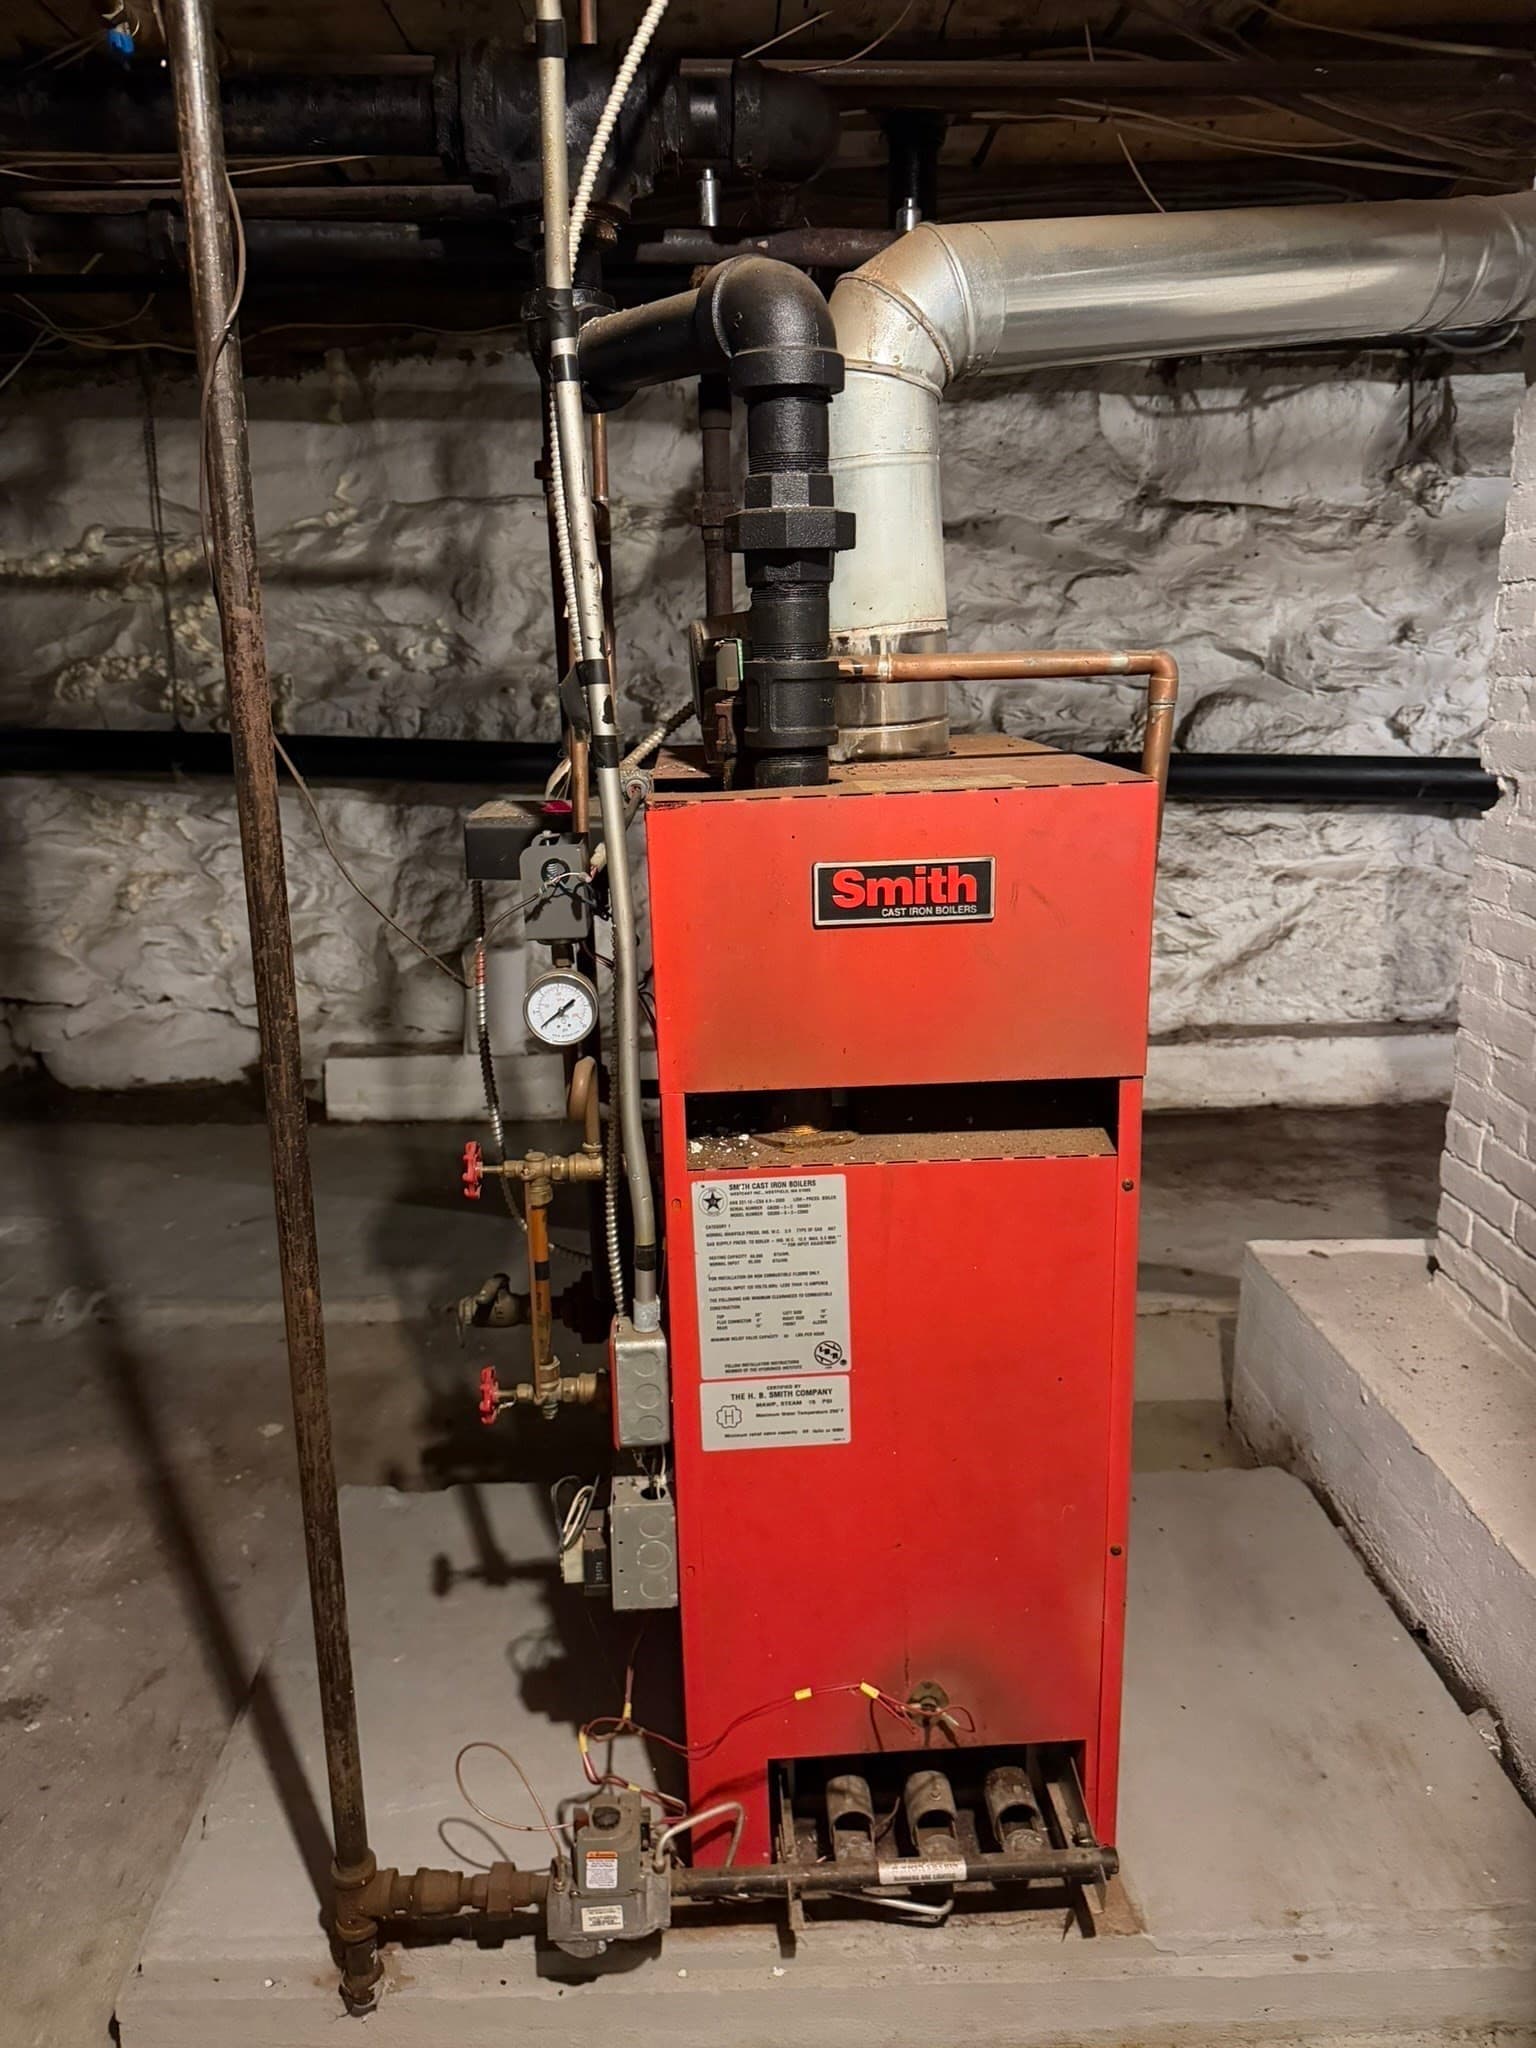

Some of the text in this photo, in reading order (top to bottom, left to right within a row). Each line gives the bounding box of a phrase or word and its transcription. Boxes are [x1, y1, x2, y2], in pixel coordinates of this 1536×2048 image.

[832, 865, 977, 908] Smith
[882, 905, 977, 917] CAST IRON BOILERS
[731, 1393, 745, 1401] THE
[769, 1390, 793, 1398] SMITH
[795, 1389, 832, 1397] COMPANY
